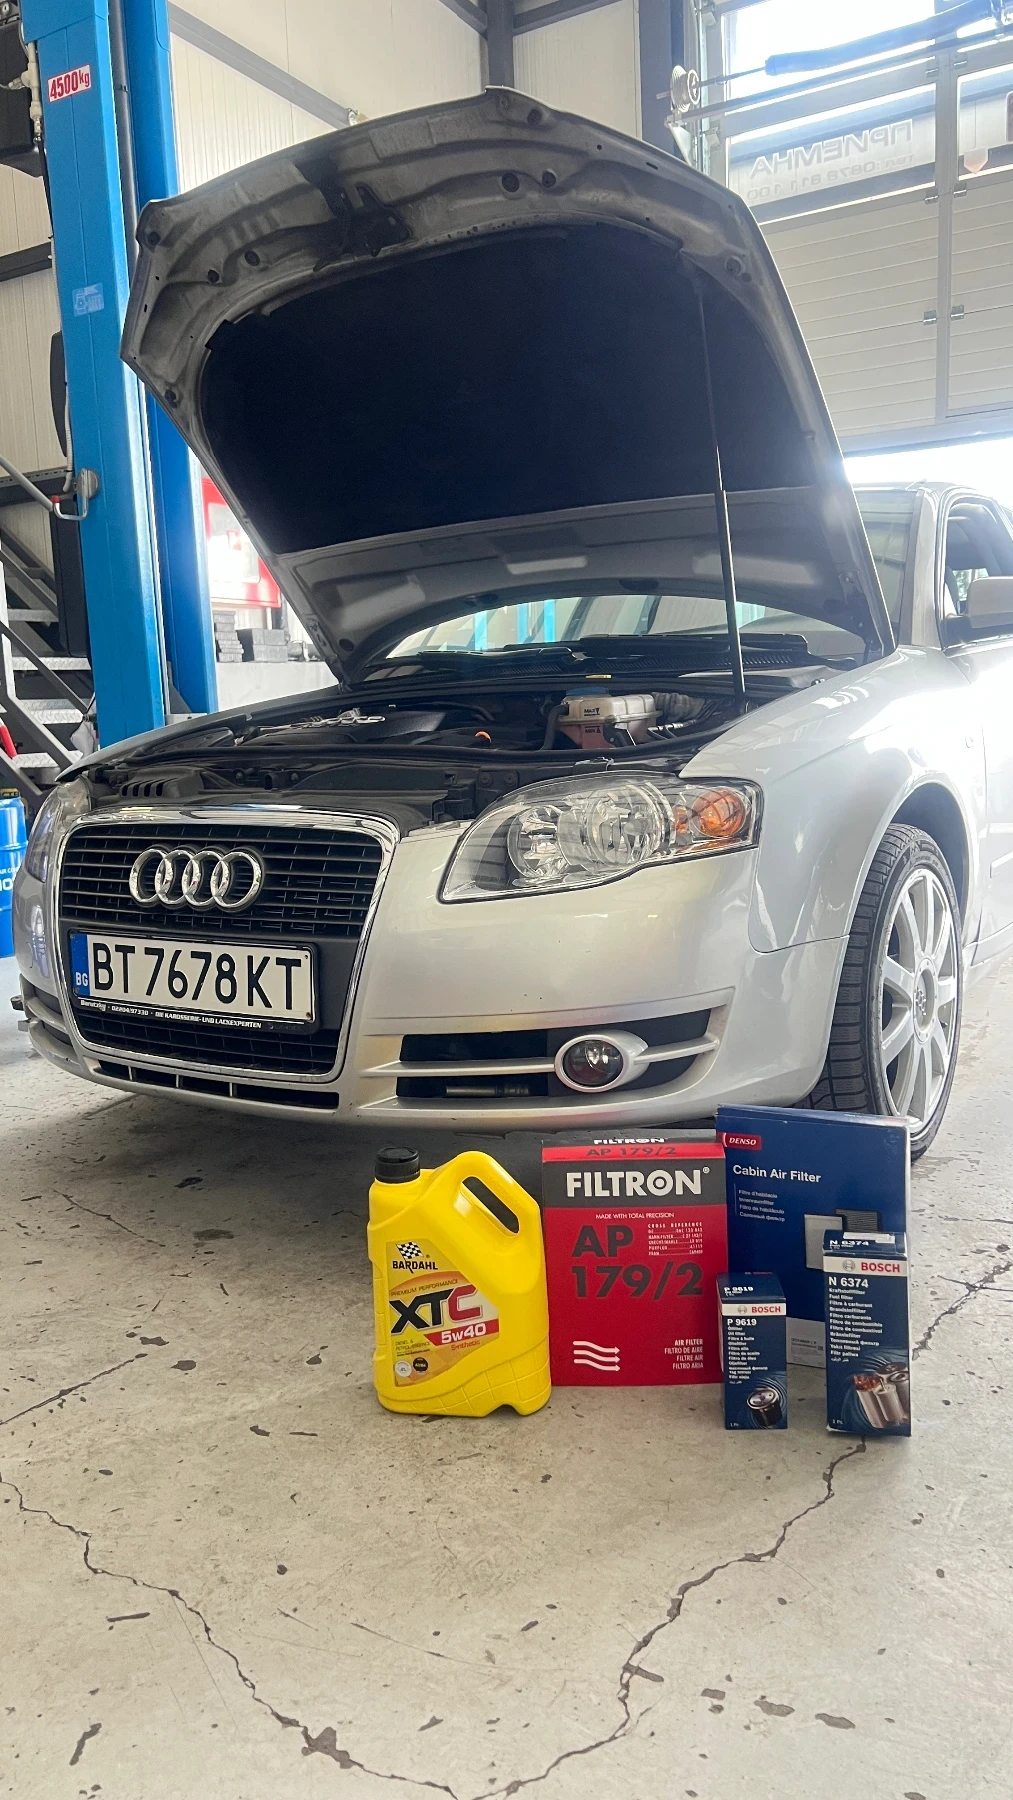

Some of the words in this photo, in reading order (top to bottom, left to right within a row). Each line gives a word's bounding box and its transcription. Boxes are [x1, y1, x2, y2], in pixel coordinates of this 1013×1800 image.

[76, 971, 89, 987] BG
[93, 942, 136, 994] BT
[144, 946, 237, 1005] 7678
[247, 955, 302, 1010] KT
[729, 1137, 757, 1146] DENSO
[620, 1147, 677, 1155] 179/2
[732, 1164, 767, 1178] Cabin
[769, 1168, 788, 1180] Air
[790, 1170, 822, 1182] Filter
[566, 1169, 702, 1198] FILTRON
[571, 1225, 634, 1257] AP
[392, 1260, 439, 1274] BARDAHL
[861, 1262, 900, 1273] BOSCH
[571, 1261, 703, 1301] 179/2
[828, 1276, 837, 1286] N
[840, 1278, 869, 1288] 6374
[390, 1287, 417, 1297] PREMIUM
[389, 1284, 482, 1334] XTC
[751, 1306, 781, 1314] BOSCH
[727, 1318, 734, 1326] P
[735, 1318, 757, 1326] 9619
[686, 1338, 703, 1346] FILTER
[683, 1346, 691, 1354] DE
